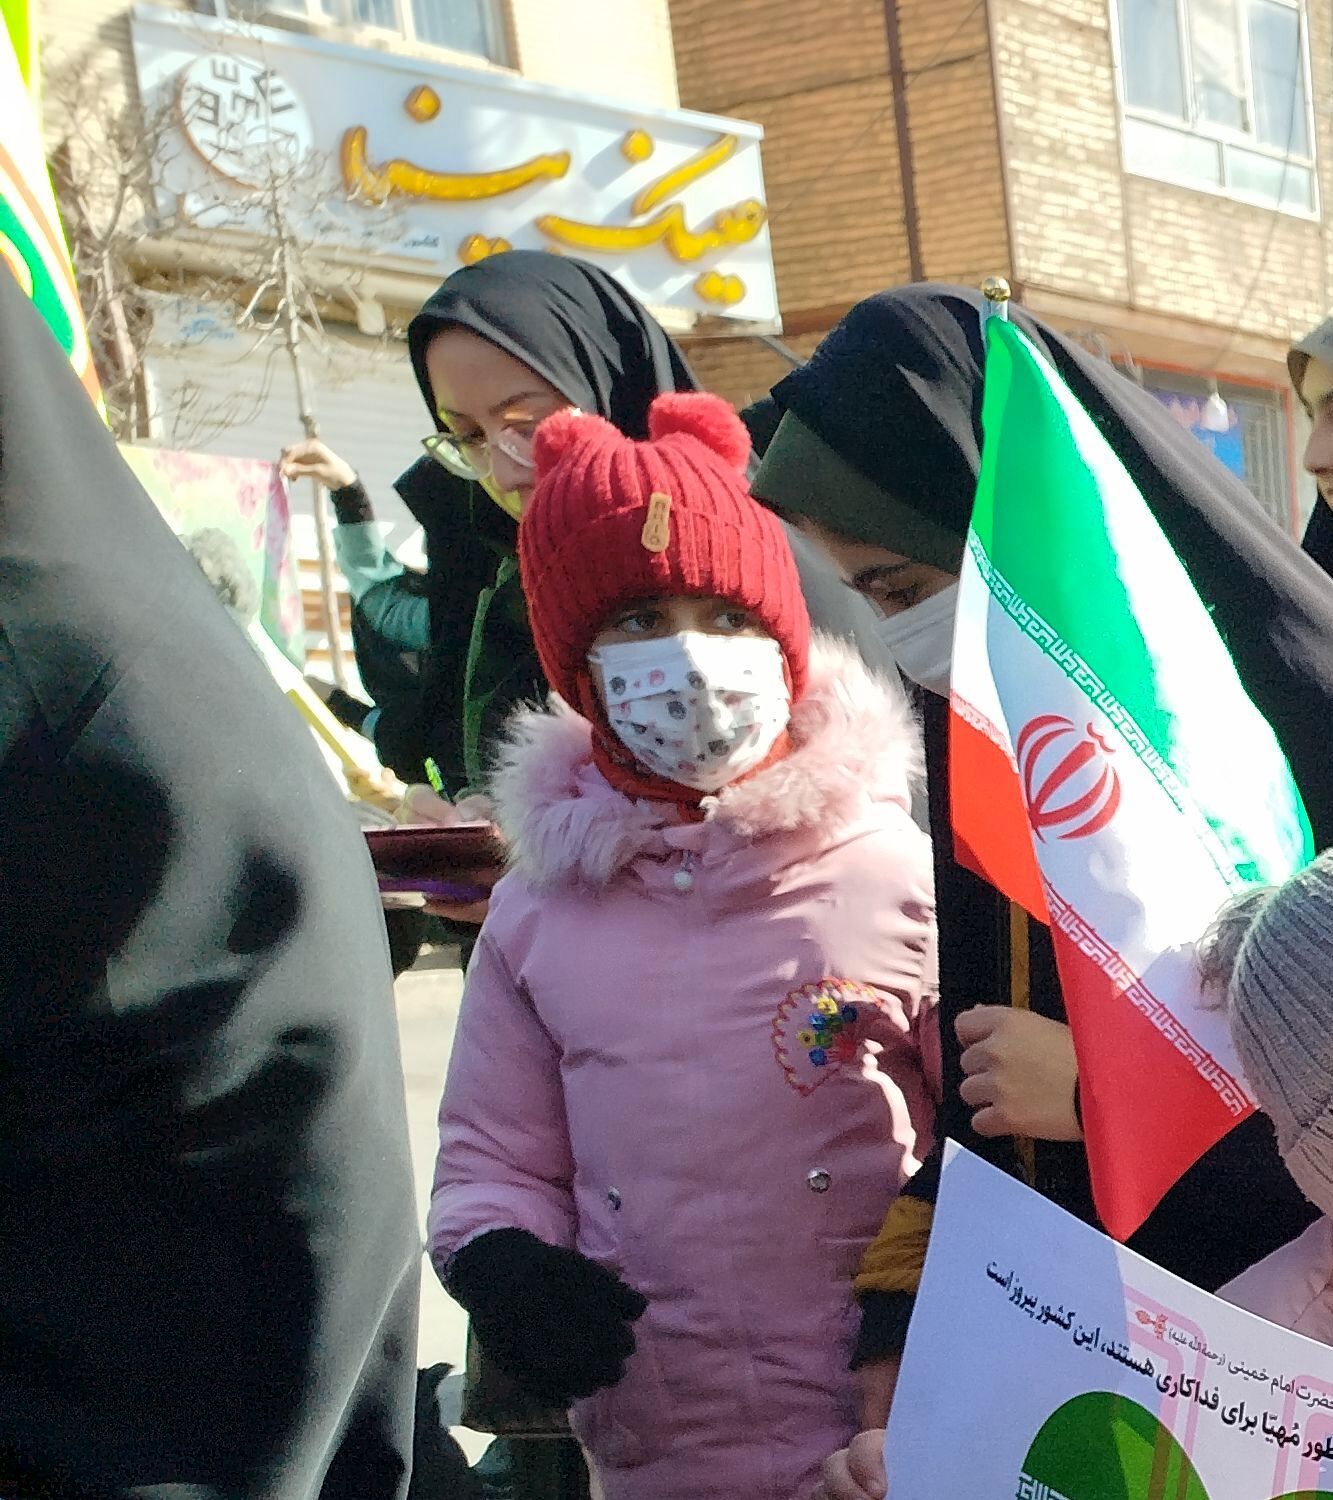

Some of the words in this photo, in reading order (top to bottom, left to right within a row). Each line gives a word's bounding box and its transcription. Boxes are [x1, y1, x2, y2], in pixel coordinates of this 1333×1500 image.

[986, 1260, 1015, 1292] است
[1009, 1284, 1038, 1317] پیروز
[1037, 1304, 1076, 1331] کشور
[1073, 1326, 1101, 1352] این
[1228, 1360, 1270, 1382] خمینی
[1271, 1374, 1296, 1396] امام
[1156, 1374, 1220, 1411] فداکاری
[1221, 1402, 1258, 1437] برای
